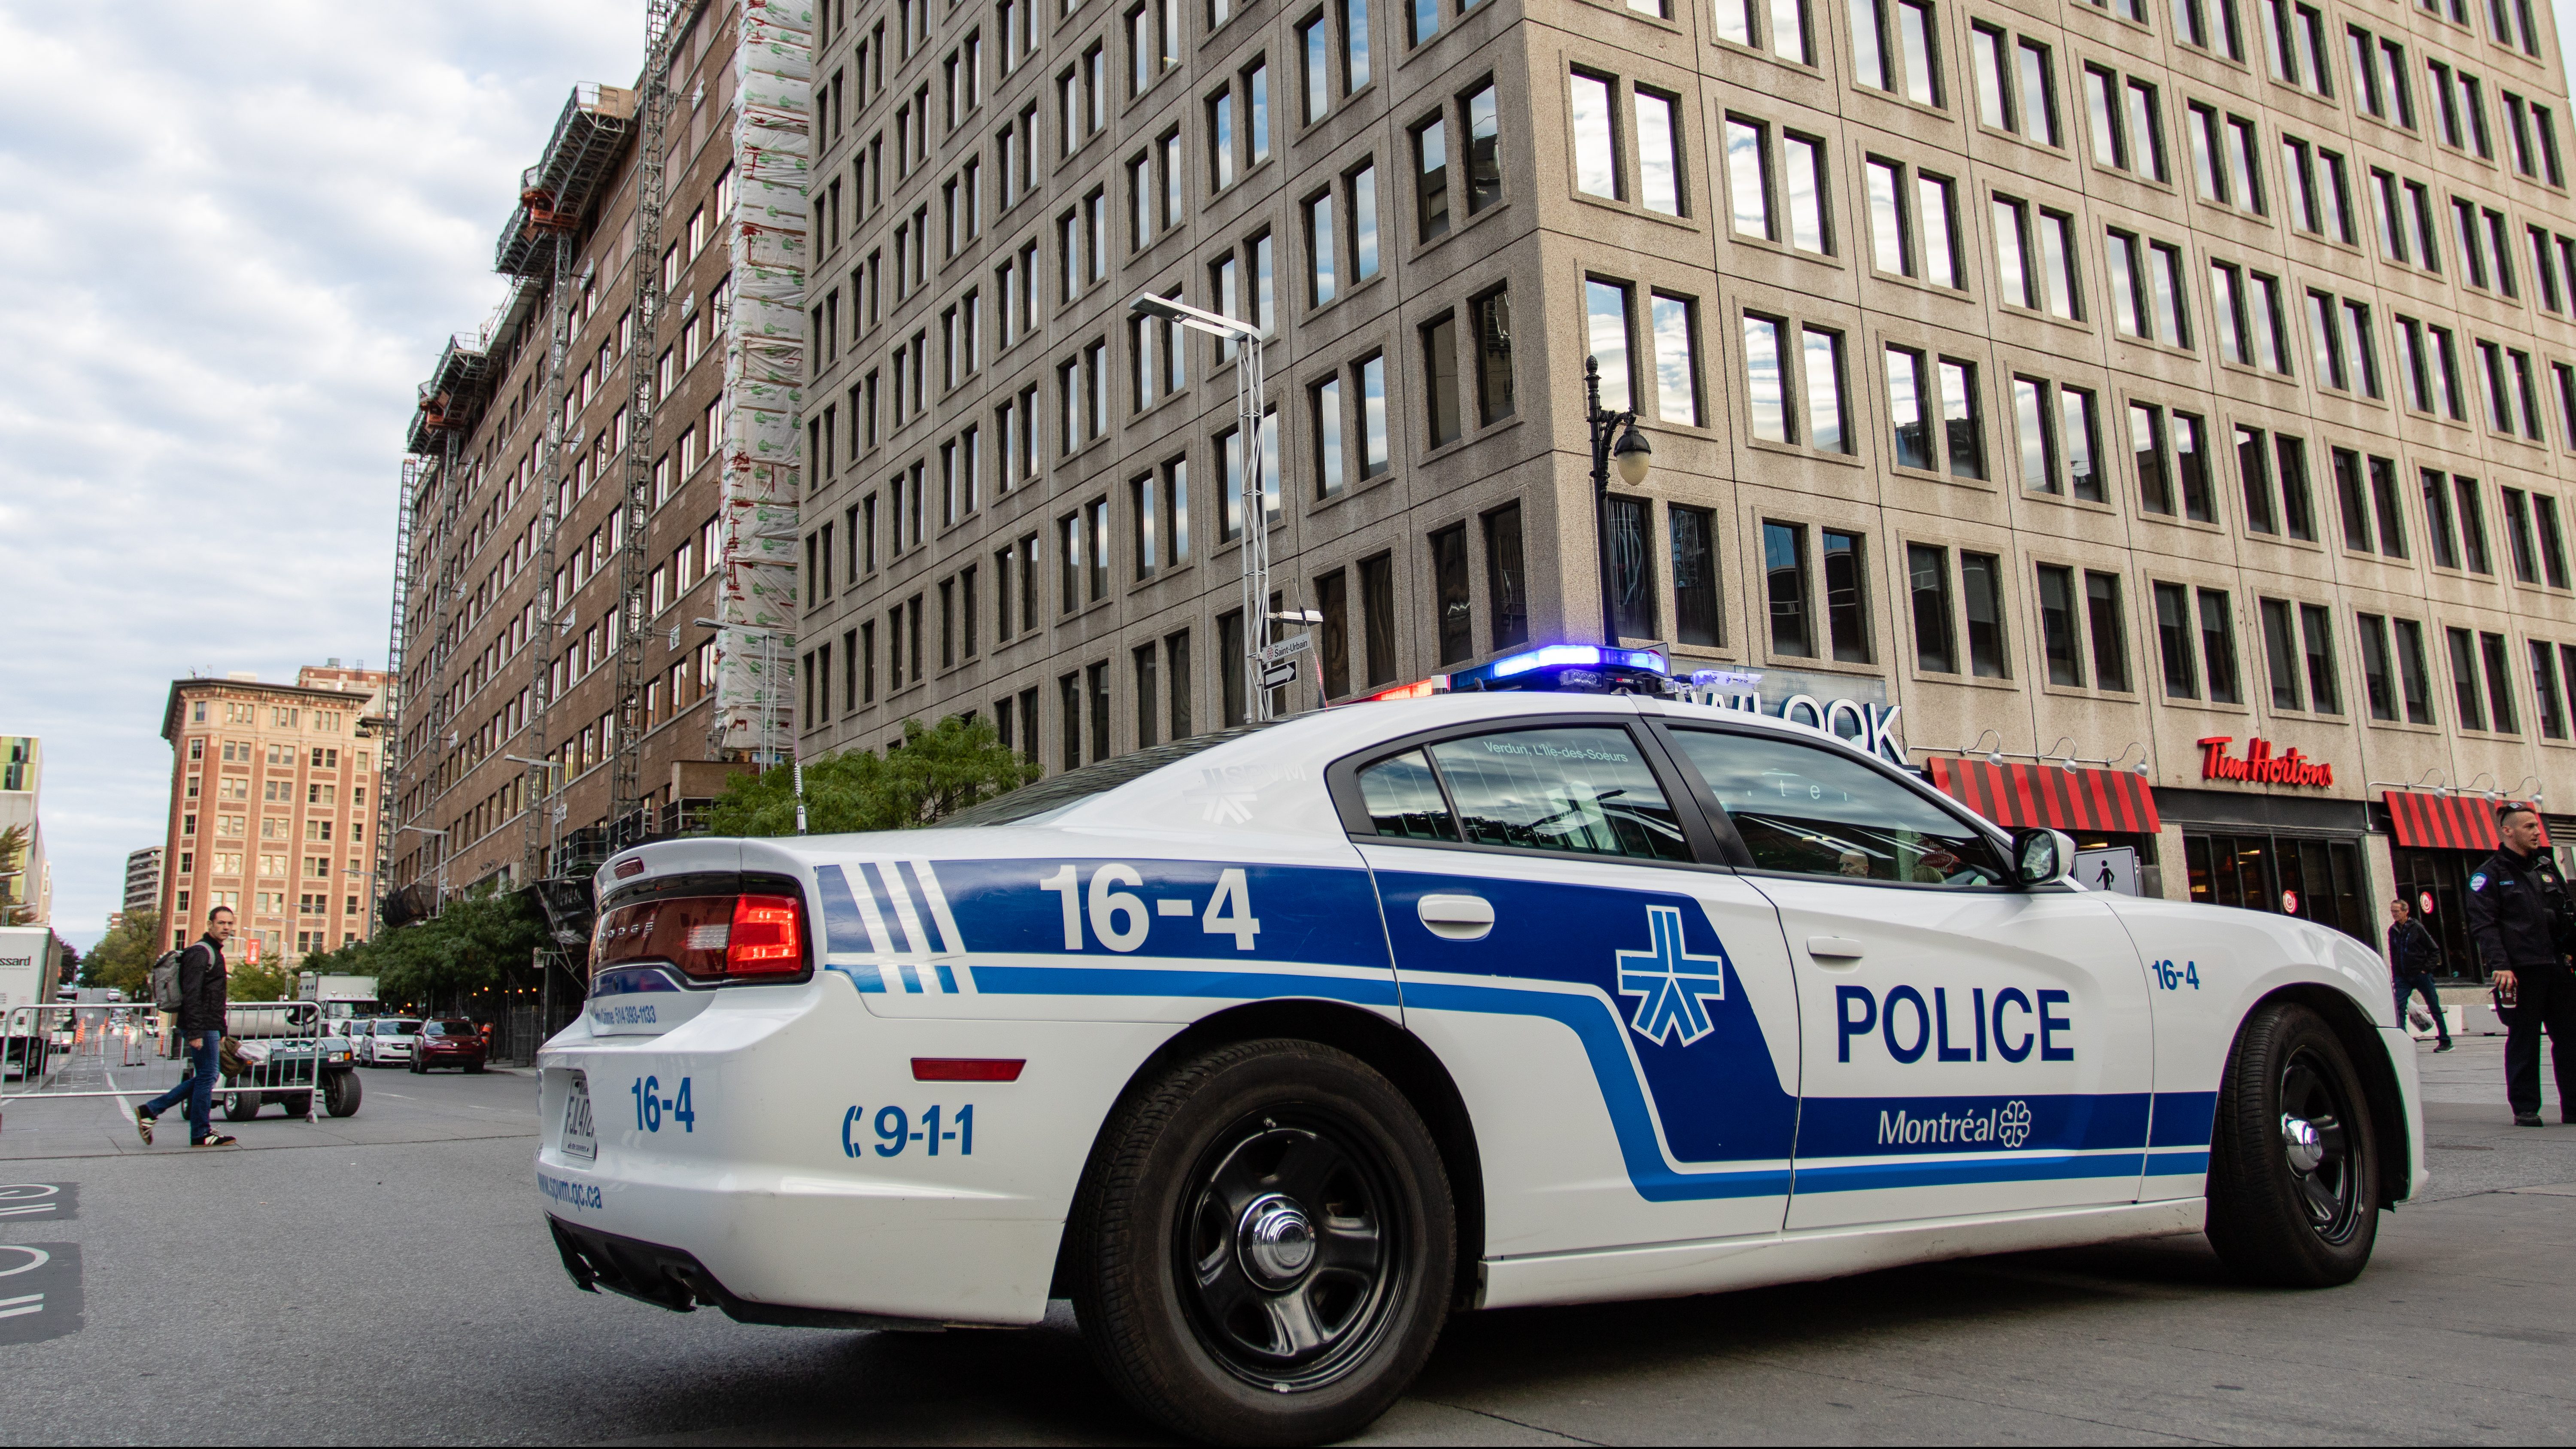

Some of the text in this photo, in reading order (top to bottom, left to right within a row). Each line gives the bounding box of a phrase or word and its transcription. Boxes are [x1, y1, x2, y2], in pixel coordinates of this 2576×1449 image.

[1274, 639, 1308, 657] Saint-Urbain
[1483, 741, 1628, 762] Verdun, L'Île-des-Soeurs
[2197, 736, 2334, 787] Tim Hortons
[1040, 863, 1261, 953] 16-4
[600, 922, 654, 940] DODGE
[2151, 960, 2200, 990] 16-4
[614, 1006, 625, 1024] 514
[625, 1005, 656, 1024] 393-1133
[1835, 984, 2074, 1064] POLICE
[631, 1075, 695, 1133] 16-4
[874, 1103, 973, 1158] 9-1-1
[1878, 1109, 1996, 1145] Montréal
[537, 1172, 603, 1212] www.spvm.qc.ca
